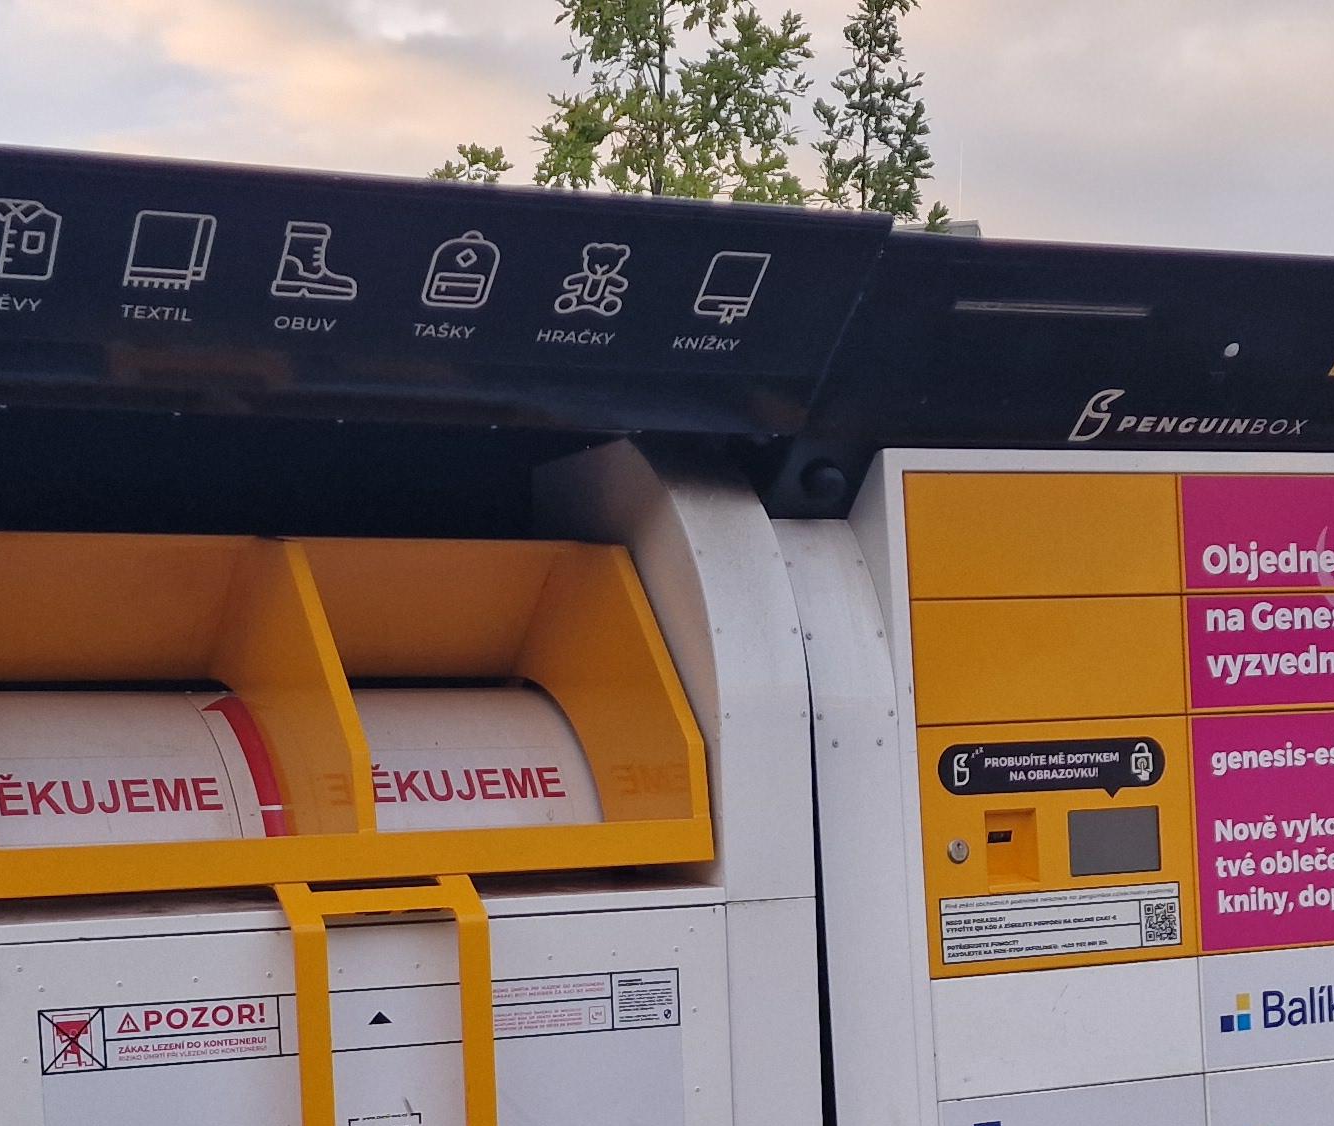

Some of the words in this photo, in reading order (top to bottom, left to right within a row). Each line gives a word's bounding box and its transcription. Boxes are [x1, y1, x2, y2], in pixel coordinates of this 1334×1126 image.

[120, 303, 193, 323] TEXTIL
[273, 313, 338, 334] OBUV
[413, 319, 476, 340] TAŠKY
[536, 326, 616, 347] HRAČKY
[671, 333, 741, 353] KNÍŽKY
[1116, 415, 1310, 436] PENGUINBOX
[1205, 606, 1244, 633] na
[984, 753, 1047, 768] PROBUDÍTE
[1048, 751, 1066, 766] MĚ
[1067, 752, 1120, 766] DOTYKEM
[371, 763, 567, 804] ĚKUJEME
[1009, 769, 1026, 782] NA
[1213, 813, 1278, 844] Nově
[1215, 851, 1256, 878] tvé
[1217, 888, 1295, 917] knihy,
[143, 1002, 266, 1032] POZOR!
[118, 1043, 150, 1055] ZÁKAZ
[152, 1041, 185, 1052] LEZENÍ
[187, 1040, 202, 1049] DO
